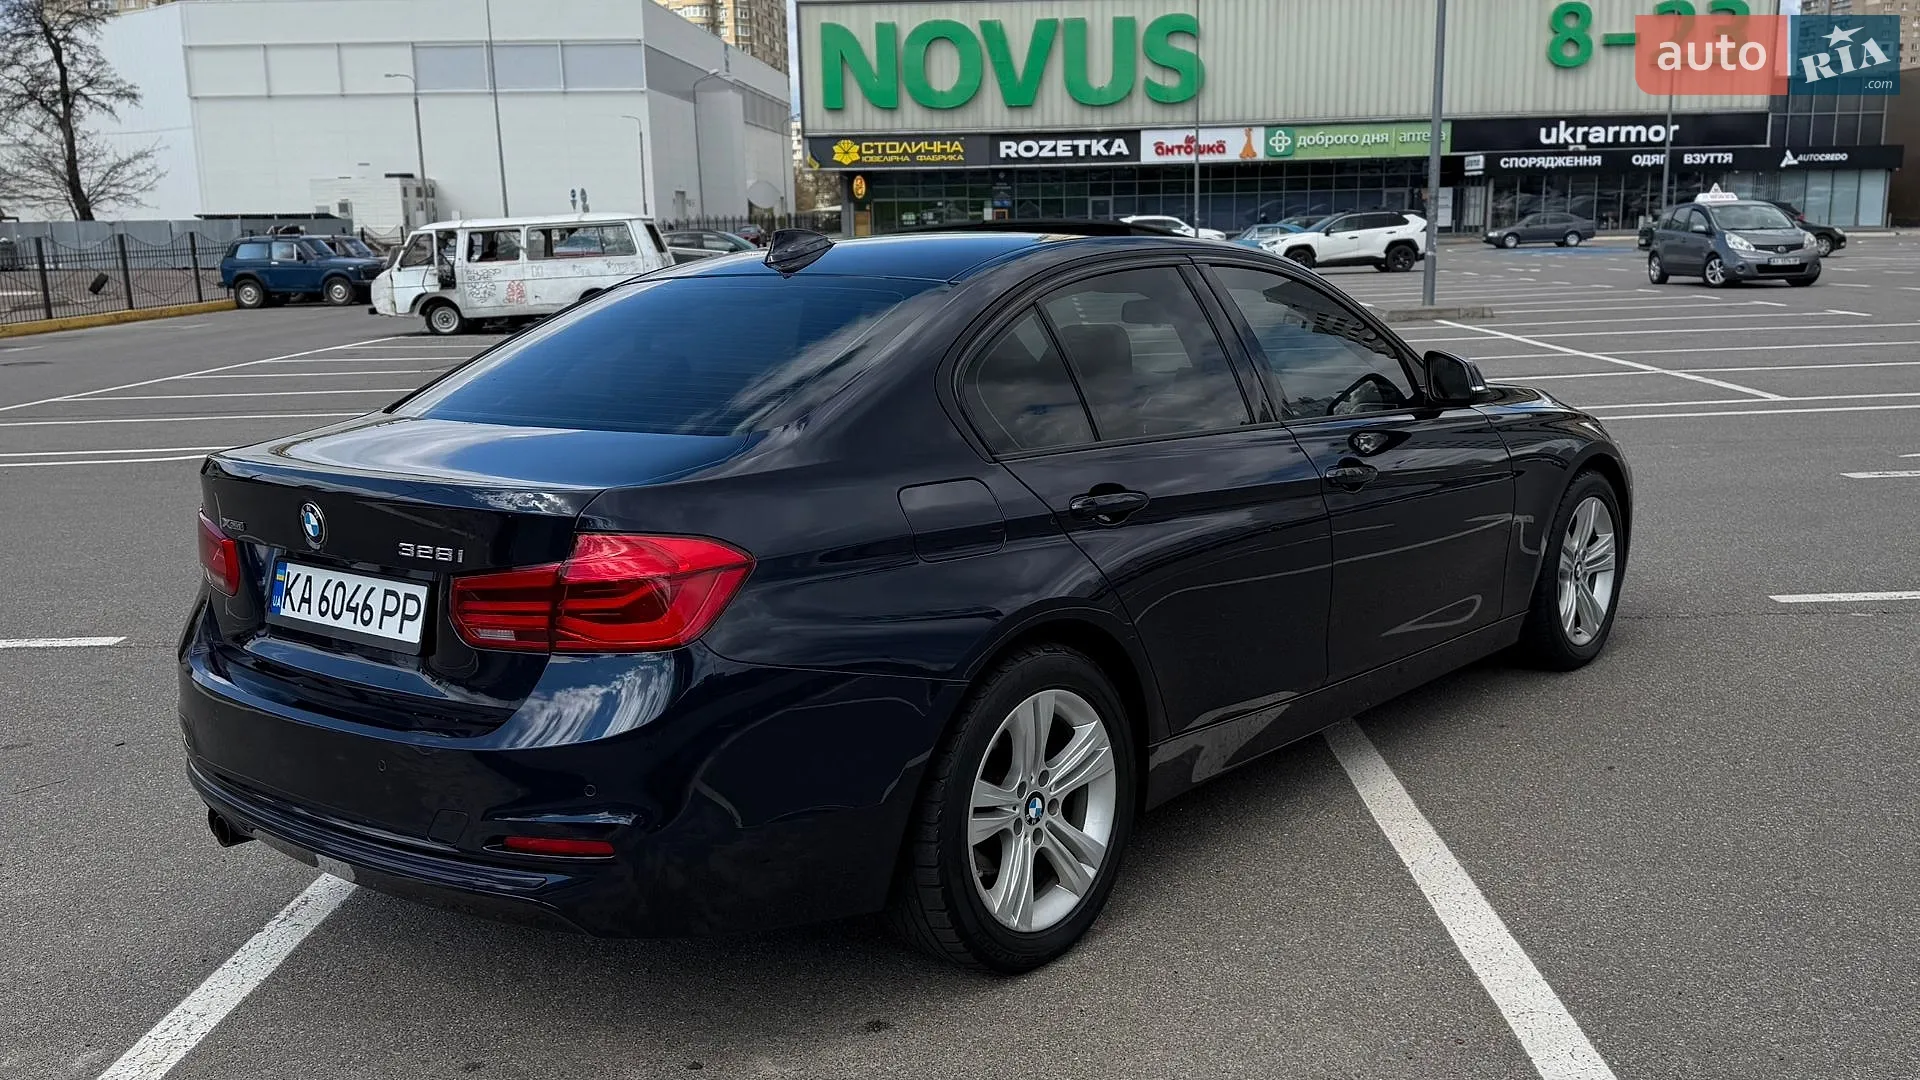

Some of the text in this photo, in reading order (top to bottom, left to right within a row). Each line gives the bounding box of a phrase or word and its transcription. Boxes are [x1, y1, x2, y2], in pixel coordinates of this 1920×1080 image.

[821, 13, 1205, 110] NOVUS
[1297, 131, 1389, 148] доброго дня
[1398, 130, 1446, 143] аптеа
[1539, 120, 1680, 145] ukrarmor
[861, 141, 964, 155] СТОЛИЧНА
[1000, 138, 1130, 158] ROZETKA
[861, 154, 964, 163] ЮВЕЛІРНА ФАБРИКА
[1500, 153, 1733, 168] СПОРЯДЖЕННЯ ОДЯГ ВЗУТТЯ
[1797, 153, 1849, 162] AUTOCREDO
[272, 597, 281, 609] UA
[282, 571, 422, 634] KA 6046 PP
